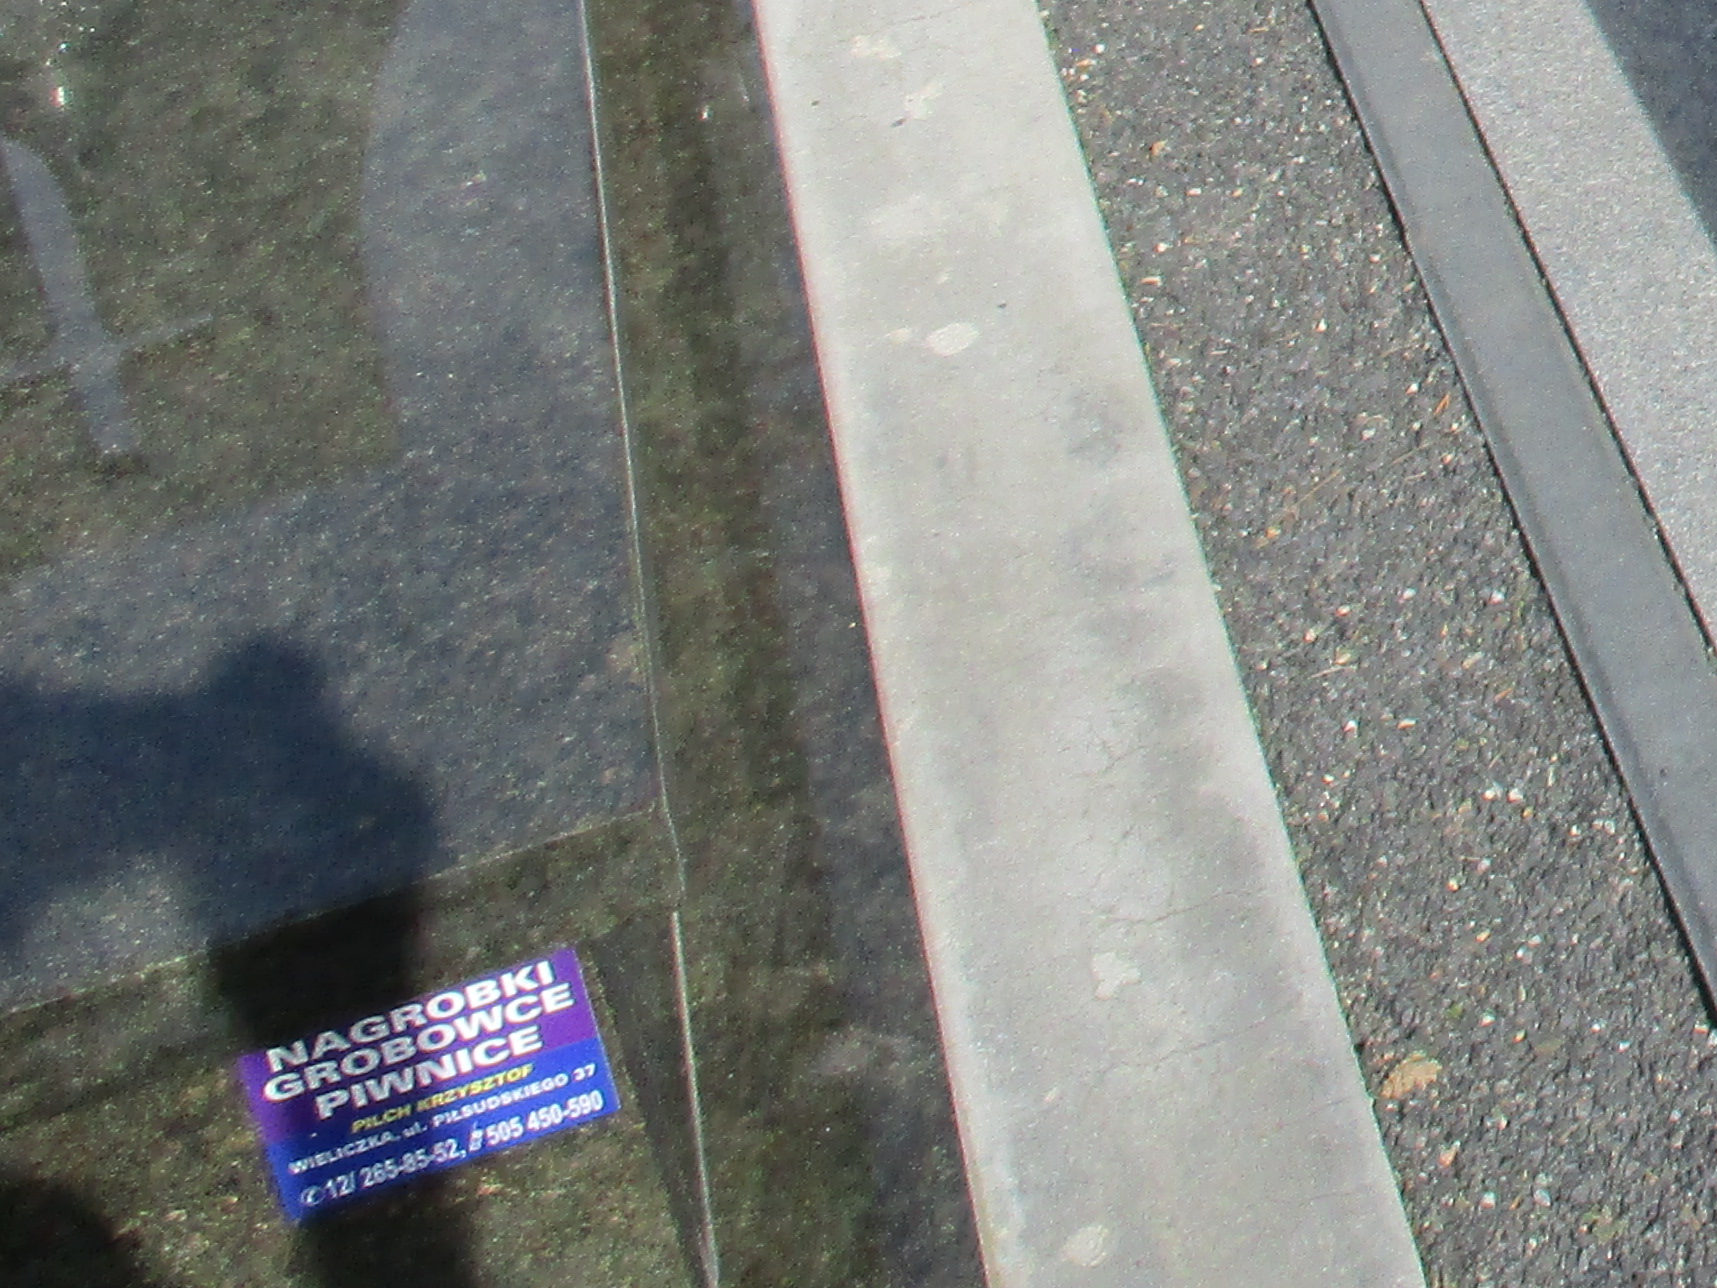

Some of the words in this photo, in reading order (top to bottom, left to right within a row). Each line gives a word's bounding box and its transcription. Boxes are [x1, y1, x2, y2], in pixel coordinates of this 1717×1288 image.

[263, 982, 575, 1103] GROBOWCE
[265, 960, 556, 1074] NAGROBKI
[313, 1026, 544, 1121] PIWNICE
[351, 1104, 412, 1134] PILCH
[416, 1062, 535, 1113] KRZYSZTOF
[401, 1121, 428, 1139] ul.
[573, 1062, 597, 1083] 37
[485, 1115, 525, 1146] 505
[527, 1089, 605, 1133] 450-590
